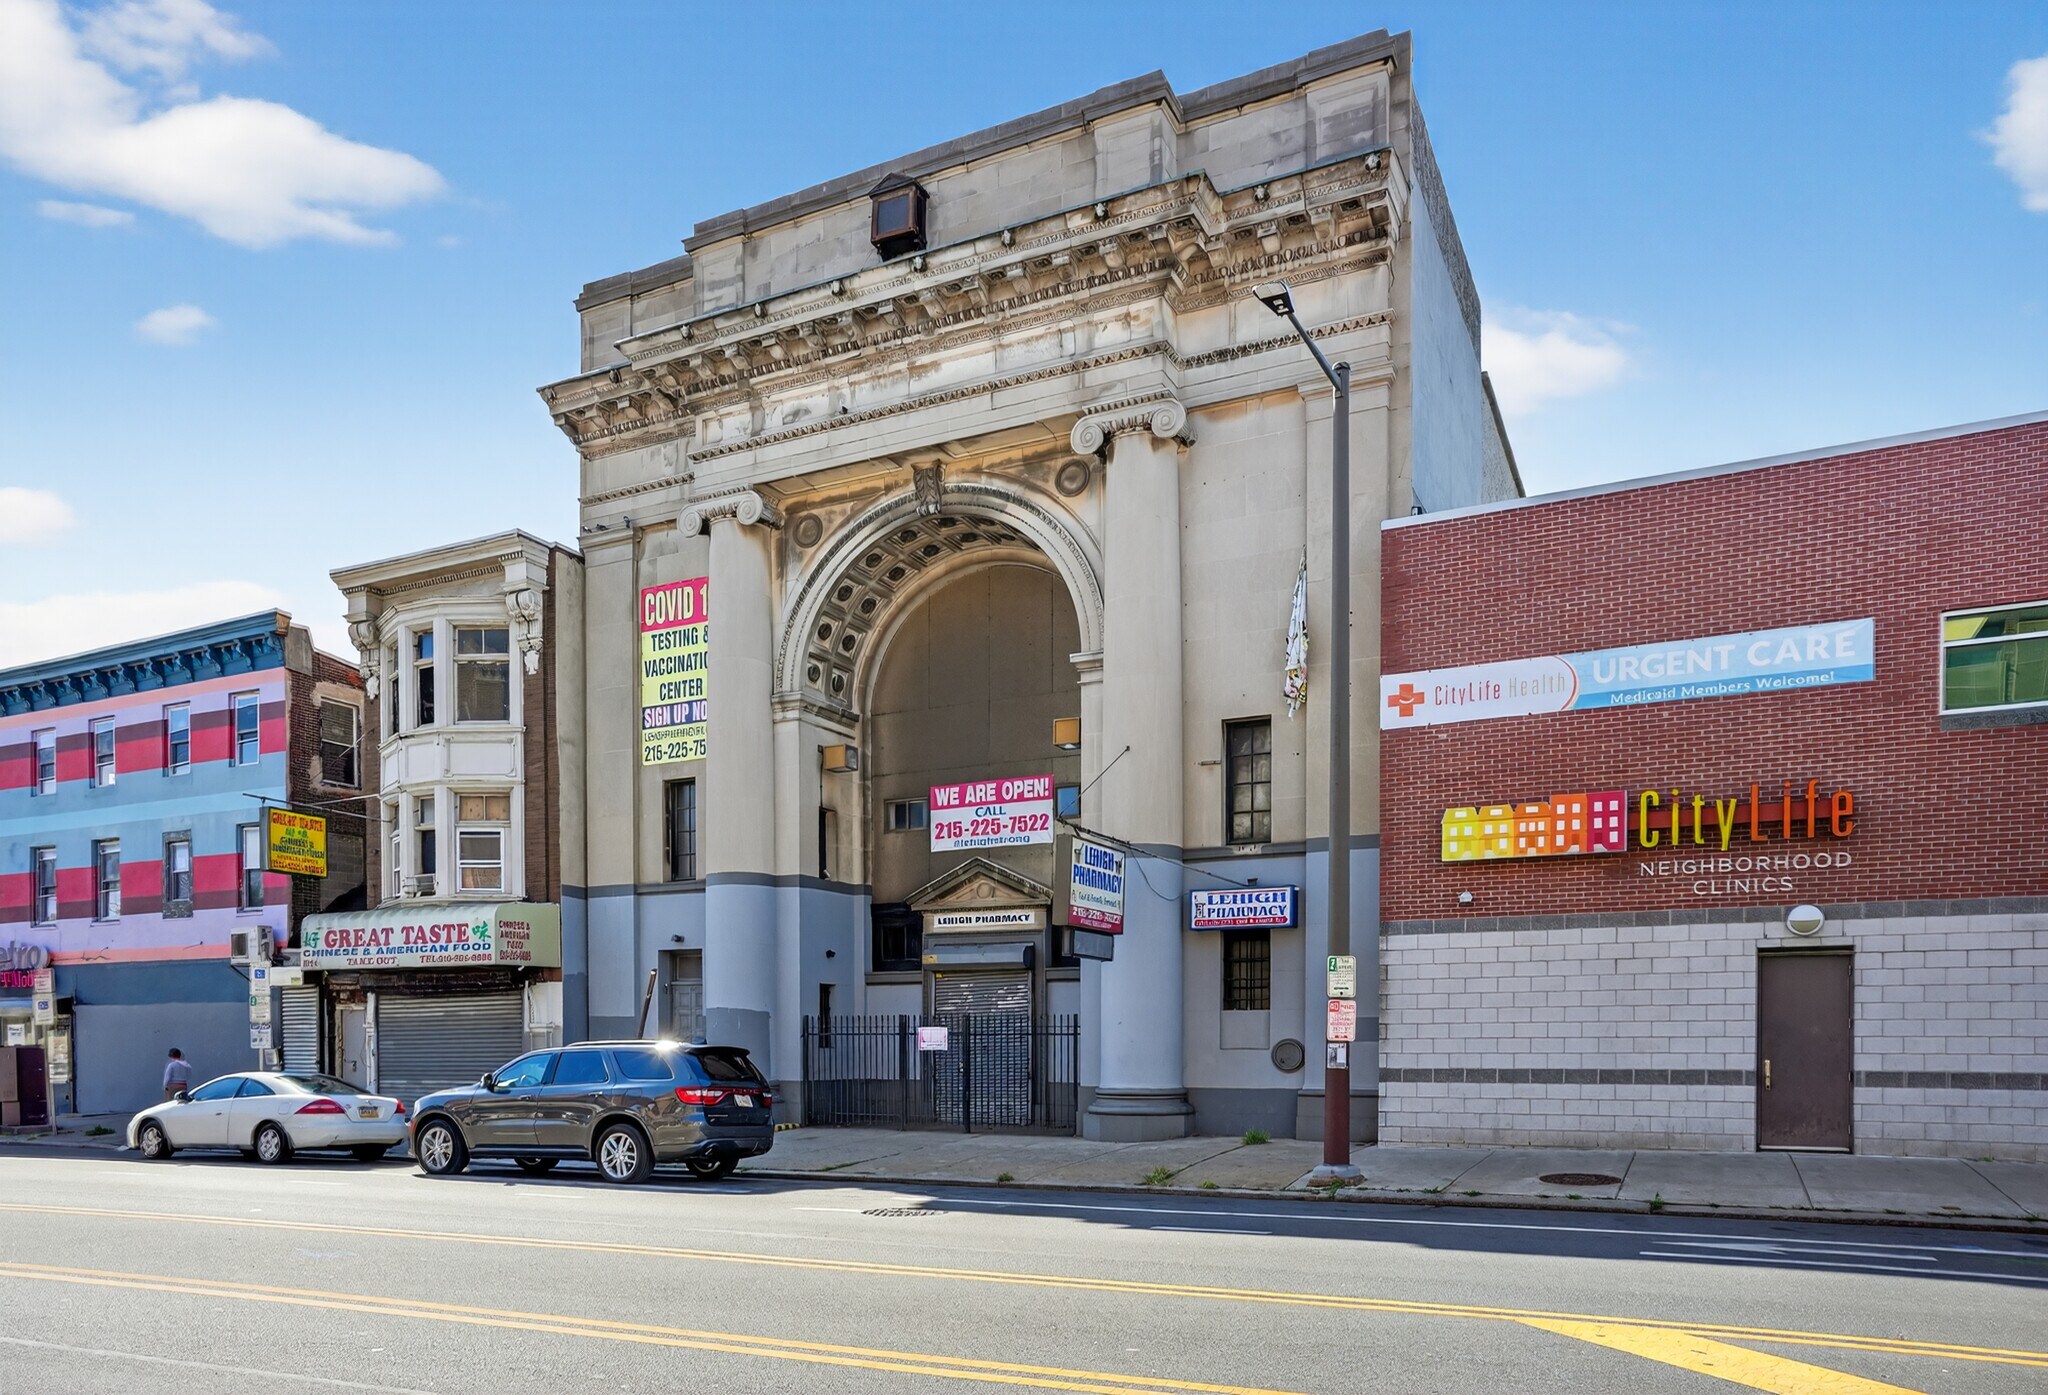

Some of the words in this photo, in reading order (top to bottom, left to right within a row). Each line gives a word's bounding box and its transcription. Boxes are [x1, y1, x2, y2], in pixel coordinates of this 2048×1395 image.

[645, 586, 694, 626] COVID
[699, 583, 708, 617] 1
[651, 627, 699, 652] TESTING
[1592, 644, 1736, 684] URGENT
[1746, 629, 1856, 666] CARE
[659, 680, 704, 701] CENTER
[1434, 680, 1501, 706] CityLife
[1508, 672, 1566, 698] Health
[1610, 688, 1676, 705] Medicaid
[1681, 681, 1751, 697] Members
[1755, 671, 1835, 689] Welcome!
[644, 705, 671, 729] SIGN
[673, 703, 690, 724] UP
[935, 786, 960, 806] WE
[965, 783, 997, 804] ARE
[1001, 778, 1050, 800] OPEN!
[975, 806, 1007, 817] CALL
[935, 813, 1050, 839] 215-225-7522
[1084, 845, 1115, 871] LEHIGH
[1640, 852, 1852, 877] NEIGHBORHOOD
[1073, 864, 1122, 894] PHARMACY
[1693, 877, 1794, 895] CLINICS
[1207, 892, 1287, 906] LEHIGH
[937, 916, 972, 925] LEHIGH
[975, 913, 1031, 924] PHARMACY
[324, 927, 395, 949] GREAT
[400, 923, 470, 946] TASTE
[303, 947, 359, 957] CHINESE
[376, 944, 450, 955] AMERICAN
[452, 943, 492, 952] FOOD
